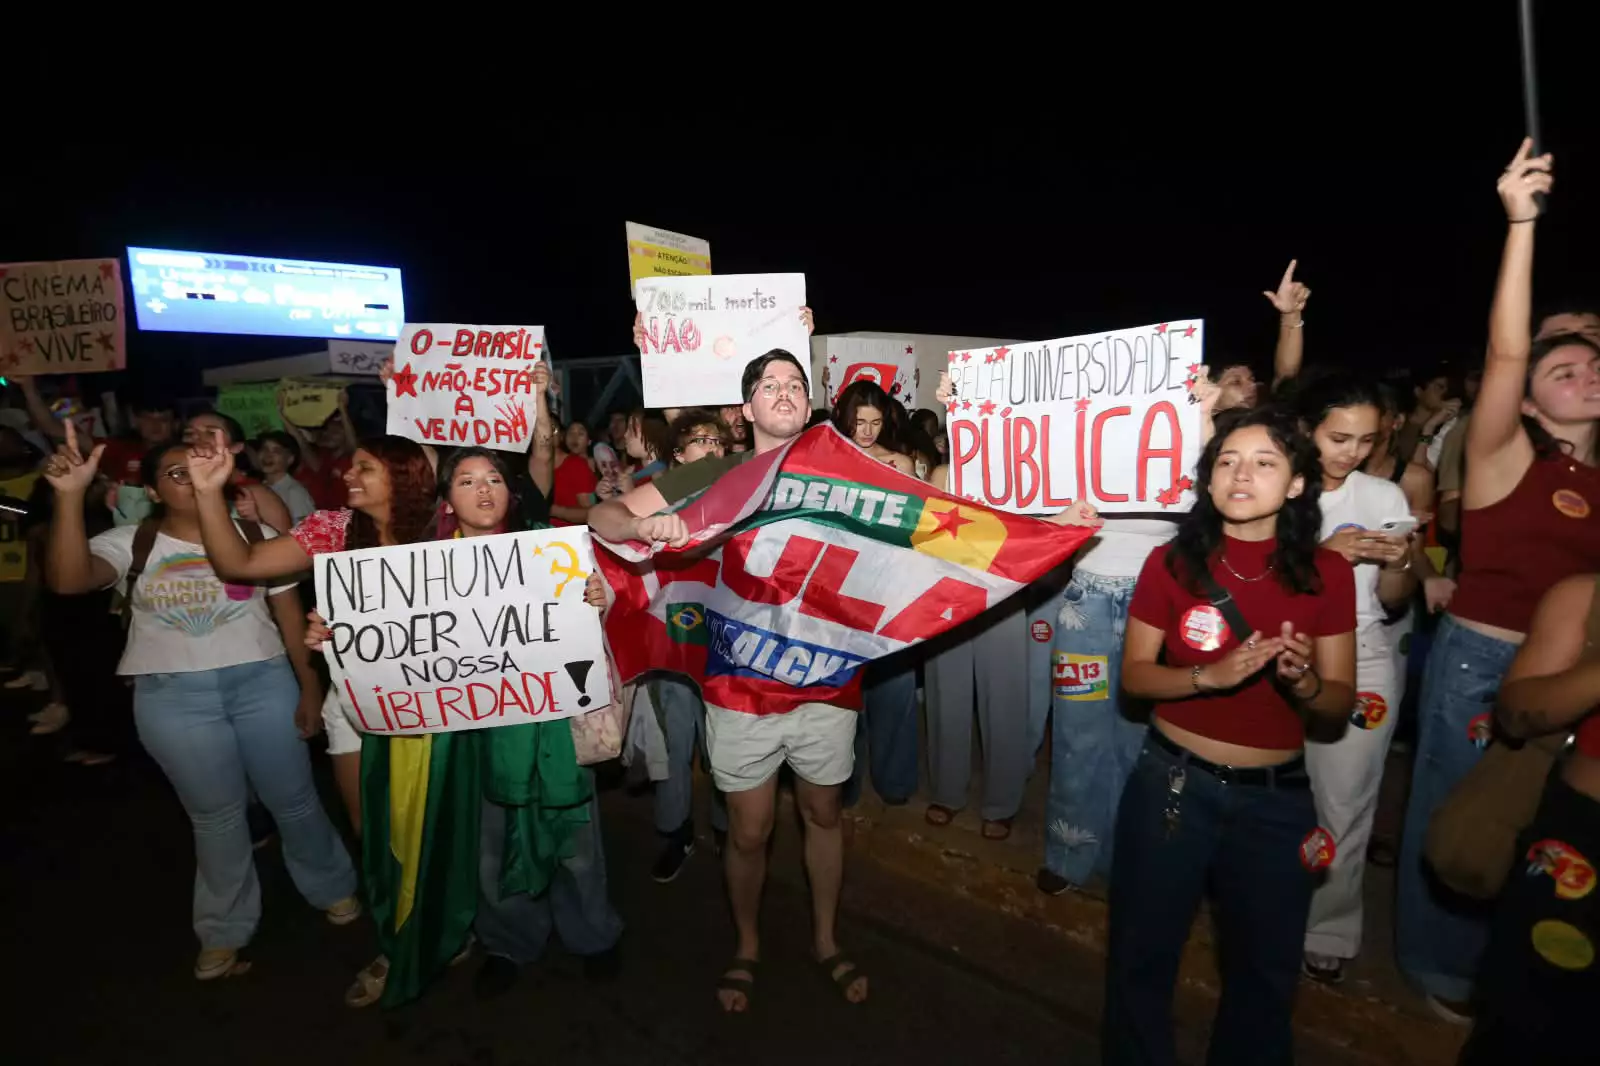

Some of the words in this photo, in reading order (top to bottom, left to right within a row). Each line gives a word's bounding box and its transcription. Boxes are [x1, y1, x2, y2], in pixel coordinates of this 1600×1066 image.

[4, 272, 105, 302] CINEMA
[641, 286, 686, 313] 700
[688, 287, 716, 311] mil
[725, 287, 777, 311] mortes
[10, 299, 117, 333] BRASILEIRO
[640, 312, 702, 355] NÃO
[34, 332, 94, 362] VIVE
[1009, 329, 1189, 406] UNIVERSIDADE
[414, 417, 513, 445] VENDA
[951, 400, 1184, 509] PÚBLICA
[326, 538, 525, 622] NENHUM
[330, 610, 461, 669] PODER
[472, 602, 561, 648] VALE
[401, 650, 521, 687] NOSSA
[731, 629, 863, 688] ALCK
[1081, 661, 1100, 680] 13
